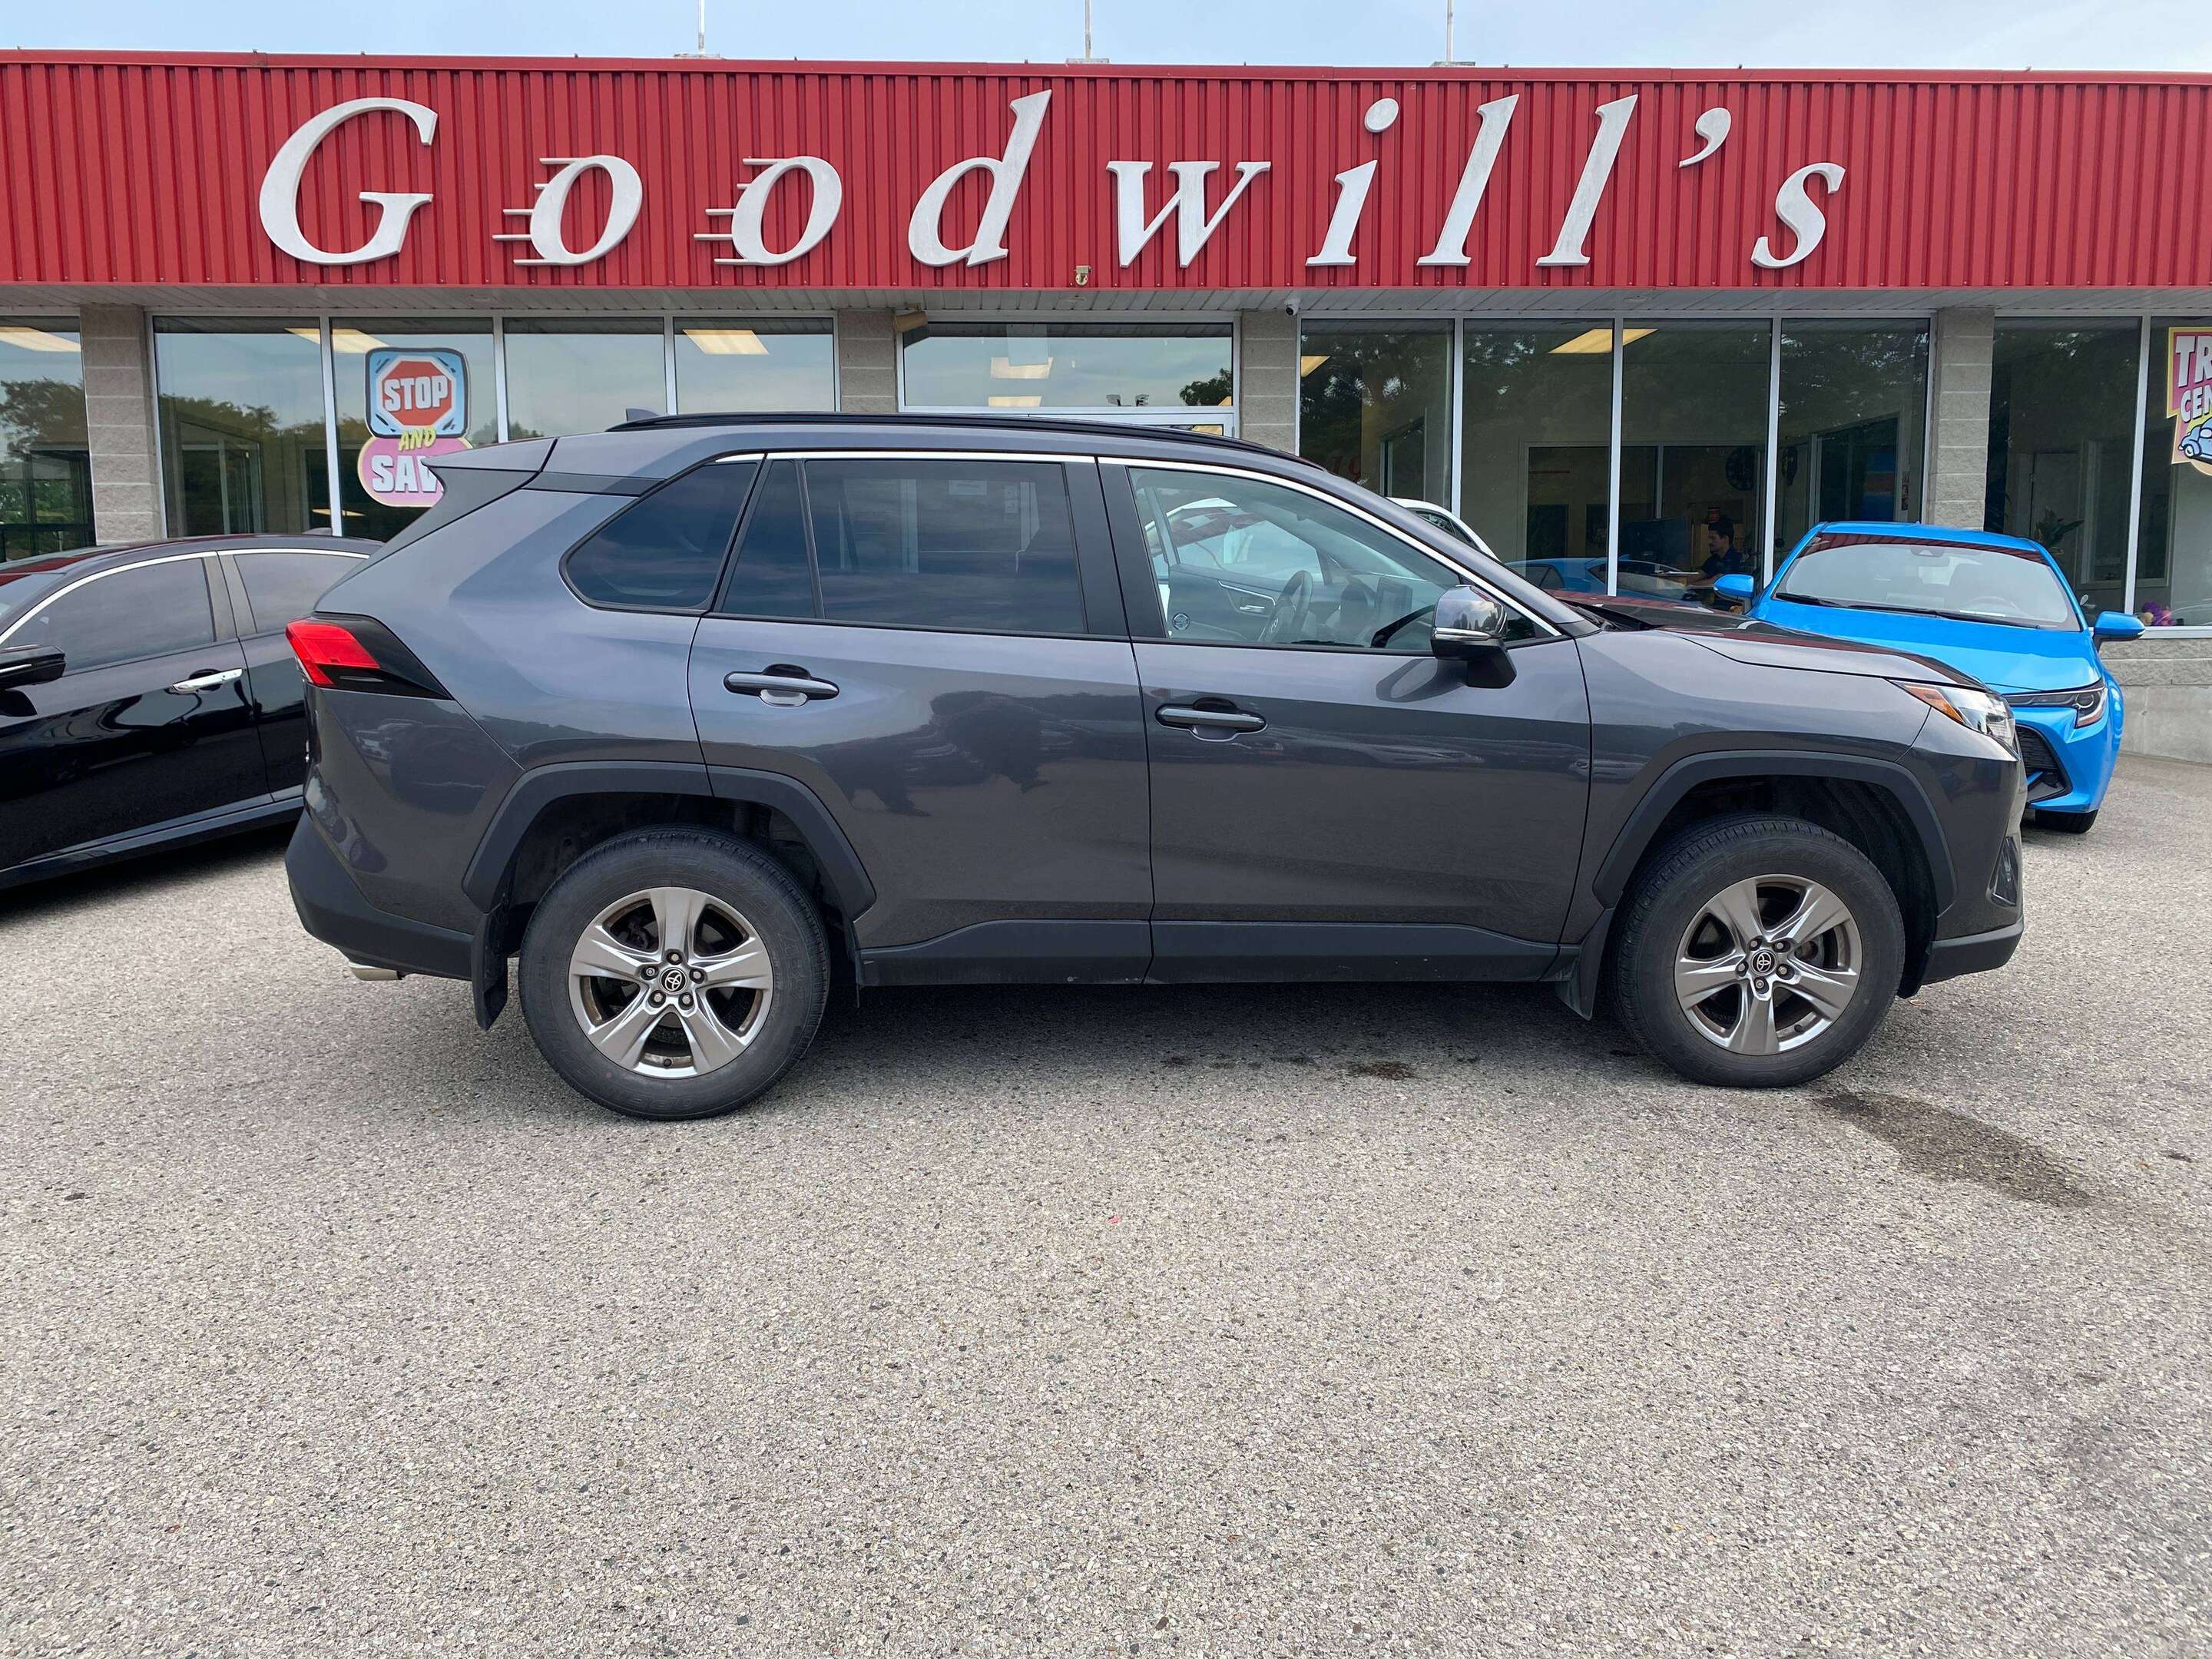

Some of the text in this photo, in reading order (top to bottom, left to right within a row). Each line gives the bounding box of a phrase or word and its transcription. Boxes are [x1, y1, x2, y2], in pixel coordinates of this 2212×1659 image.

[259, 89, 1846, 270] Goodwill's
[384, 375, 448, 412] STOP
[399, 428, 437, 451] AND
[371, 455, 445, 492] SAV
